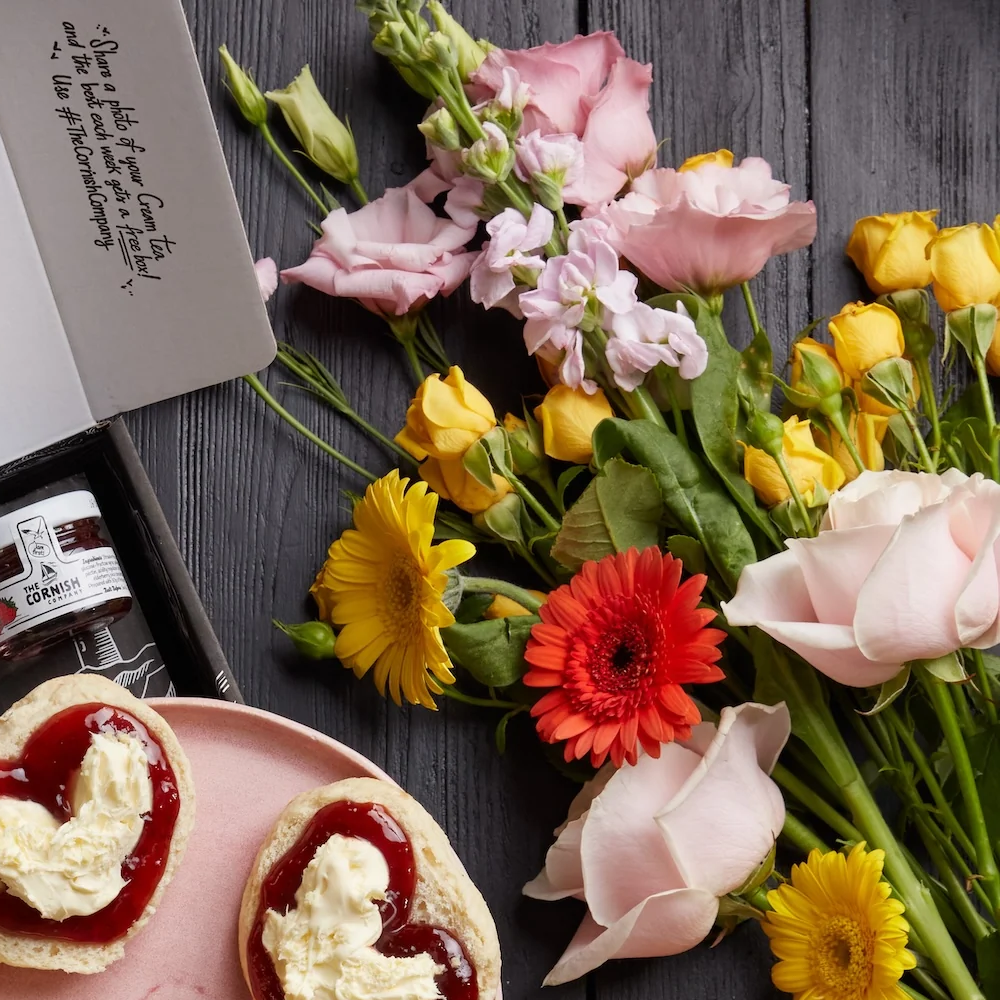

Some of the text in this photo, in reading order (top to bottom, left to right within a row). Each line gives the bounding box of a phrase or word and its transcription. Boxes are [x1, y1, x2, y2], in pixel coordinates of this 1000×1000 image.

[62, 21, 86, 49] and
[71, 53, 92, 75] the
[89, 39, 119, 78] Share
[52, 74, 72, 100] Use
[80, 83, 105, 109] best
[103, 83, 116, 92] a
[90, 113, 114, 141] each
[100, 100, 139, 131] photo
[115, 137, 146, 153] of
[100, 146, 122, 175] week
[118, 156, 144, 187] your
[104, 179, 131, 204] gets
[118, 208, 130, 219] a
[116, 224, 144, 252] free
[149, 234, 177, 261] tea
[23, 582, 40, 594] THE
[26, 577, 81, 606] CORNISH
